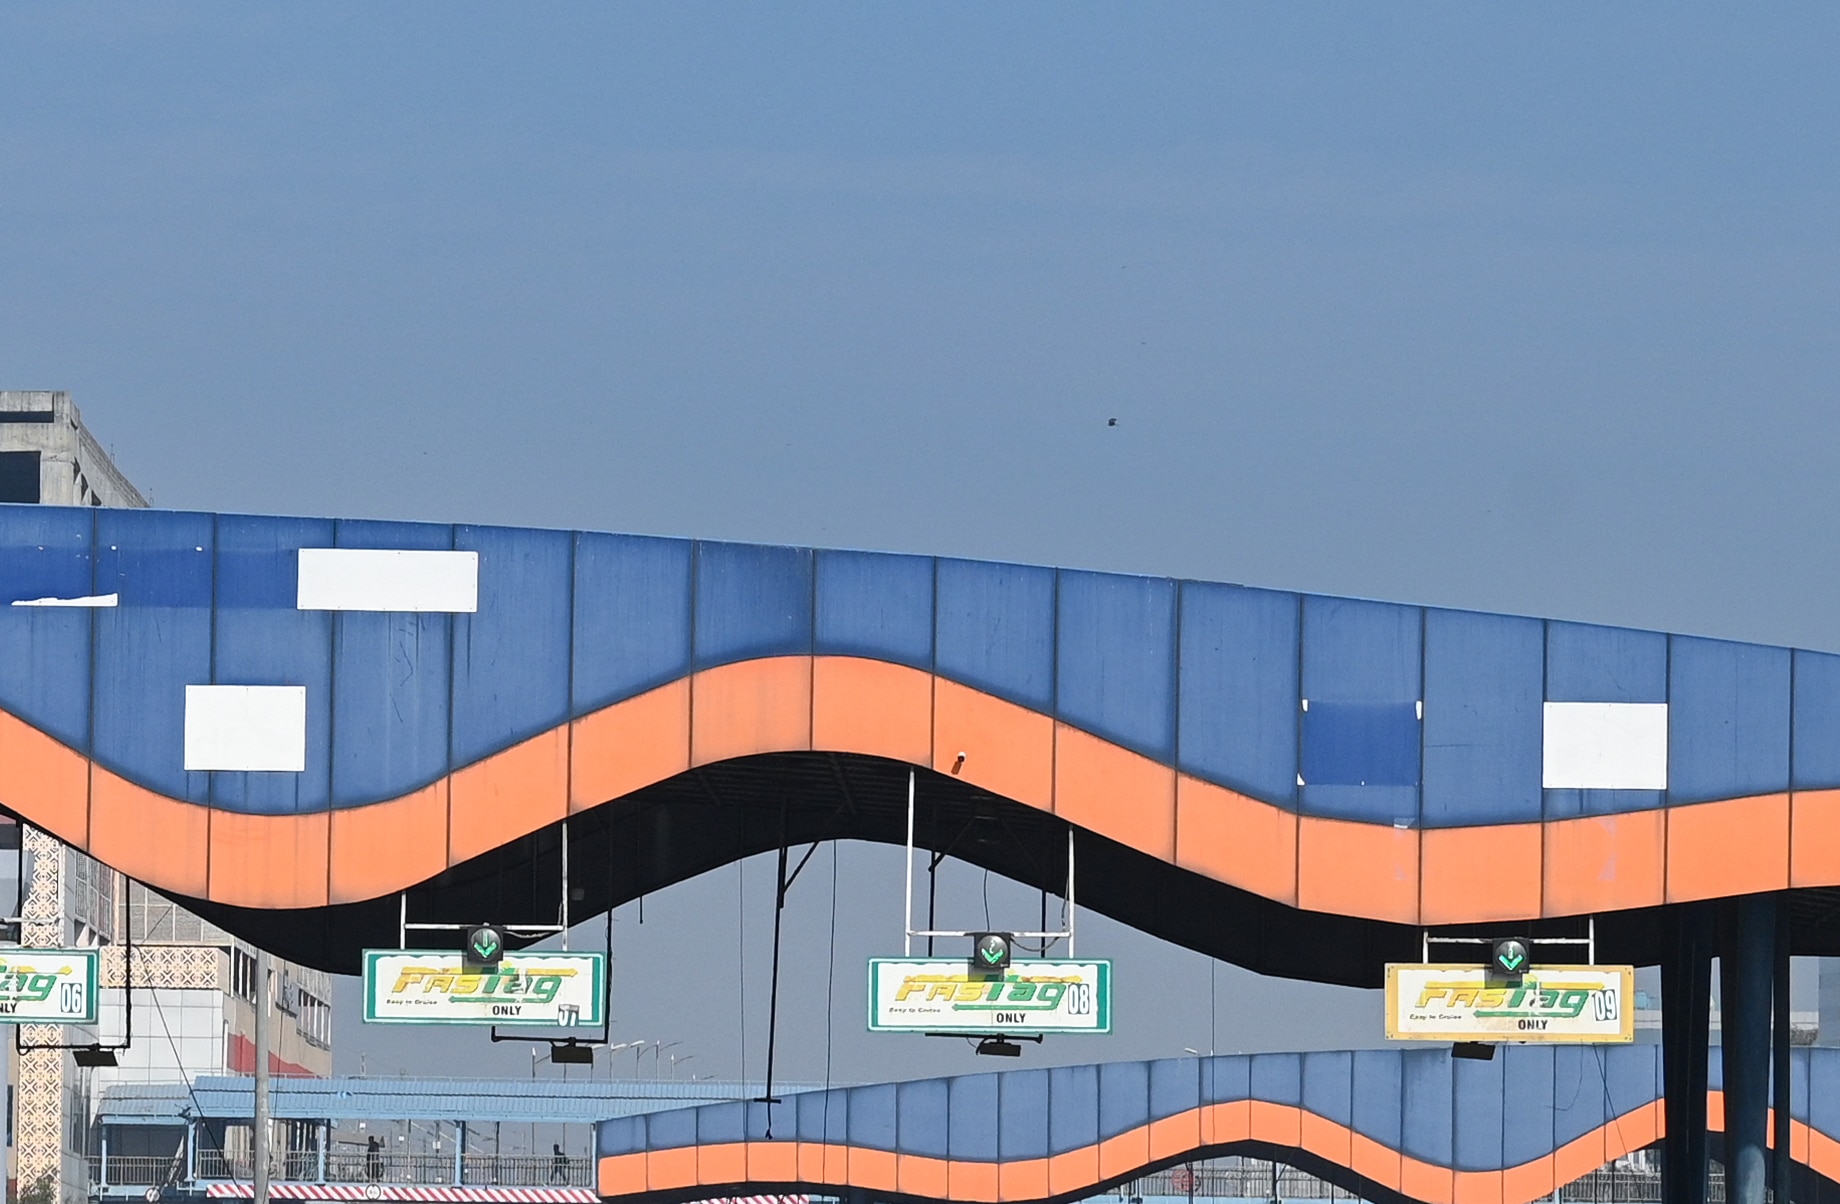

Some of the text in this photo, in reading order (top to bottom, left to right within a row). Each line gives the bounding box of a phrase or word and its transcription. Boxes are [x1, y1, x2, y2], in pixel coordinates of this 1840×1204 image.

[61, 983, 82, 1013] 06
[1068, 984, 1090, 1014] 08
[1593, 989, 1617, 1021] 09
[492, 1005, 522, 1016] ONLY
[996, 1013, 1026, 1023] ONLY
[1518, 1019, 1549, 1030] ONLY
